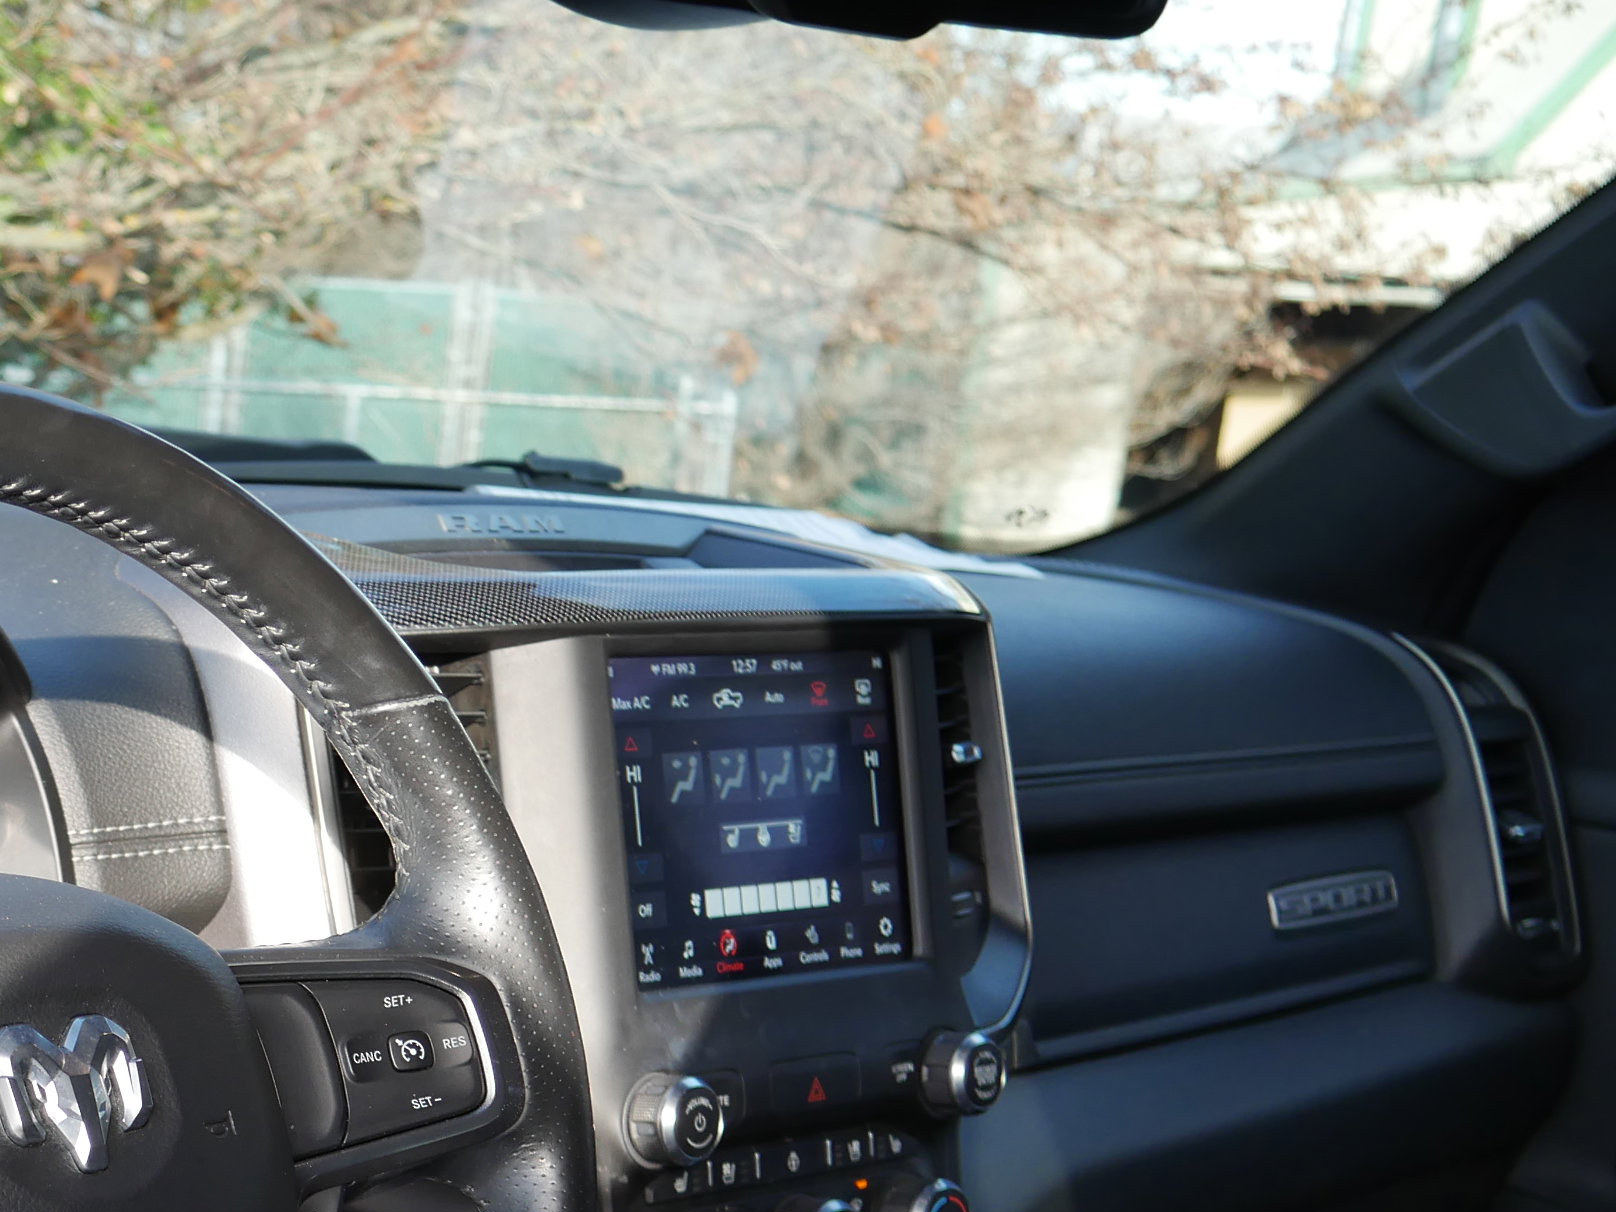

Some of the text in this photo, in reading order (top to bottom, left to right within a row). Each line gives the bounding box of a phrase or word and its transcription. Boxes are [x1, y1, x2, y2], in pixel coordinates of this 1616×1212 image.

[438, 512, 566, 534] RAM
[732, 658, 757, 673] 12:57
[671, 694, 689, 708] A/C
[864, 750, 879, 767] HI
[625, 765, 642, 783] HI
[638, 904, 653, 918] Off
[639, 971, 661, 983] Radio
[442, 1036, 467, 1051] RES
[352, 1050, 383, 1065] CANC
